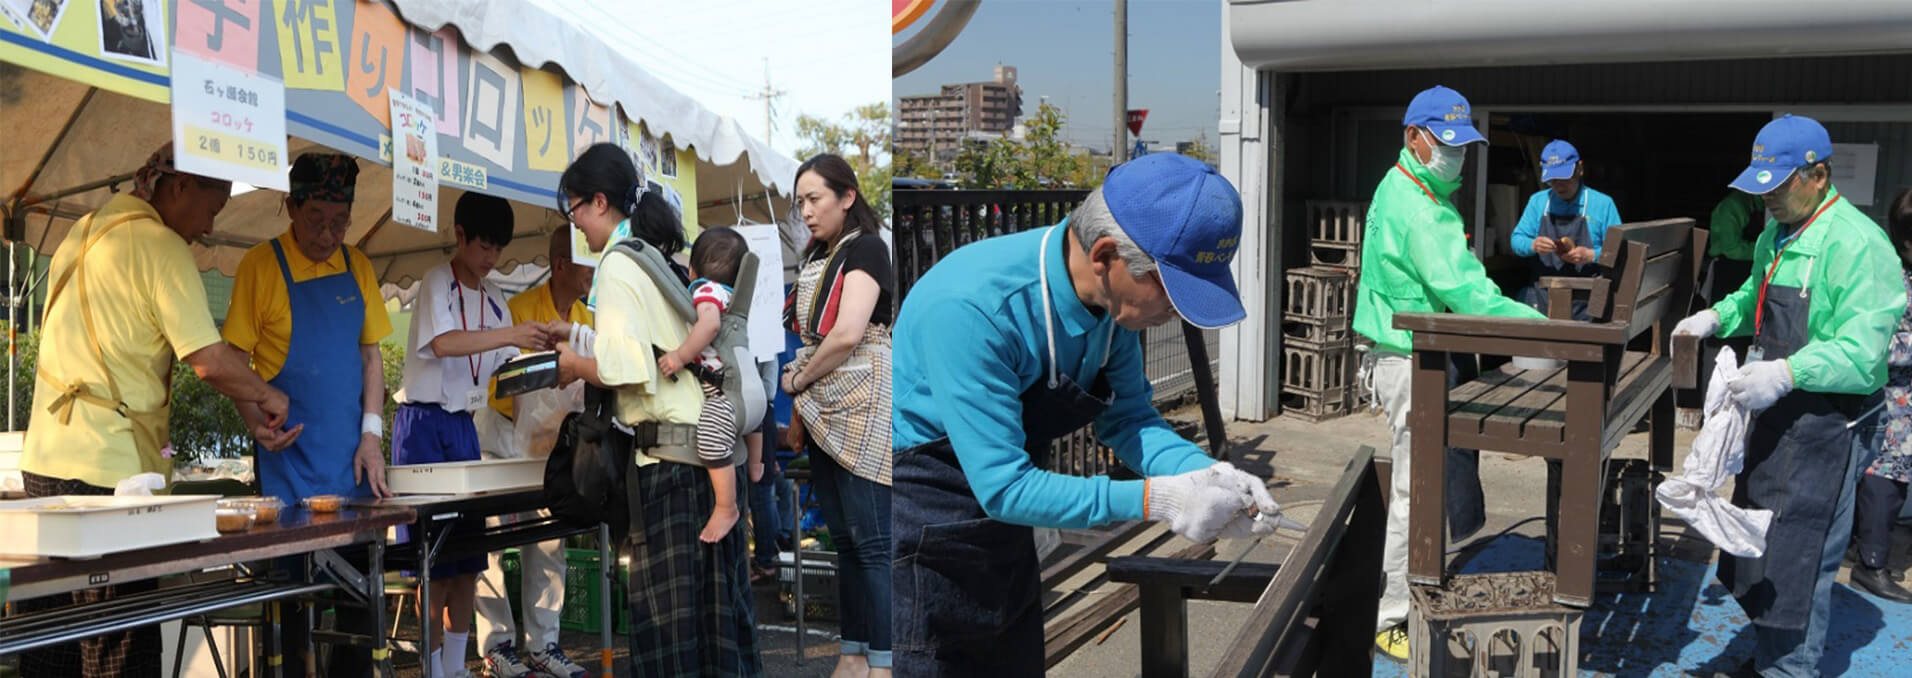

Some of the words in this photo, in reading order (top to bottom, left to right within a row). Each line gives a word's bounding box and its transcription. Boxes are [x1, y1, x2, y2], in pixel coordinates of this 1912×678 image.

[211, 111, 254, 133] コロッケ
[199, 135, 221, 154] 2個
[238, 143, 278, 166] 150円
